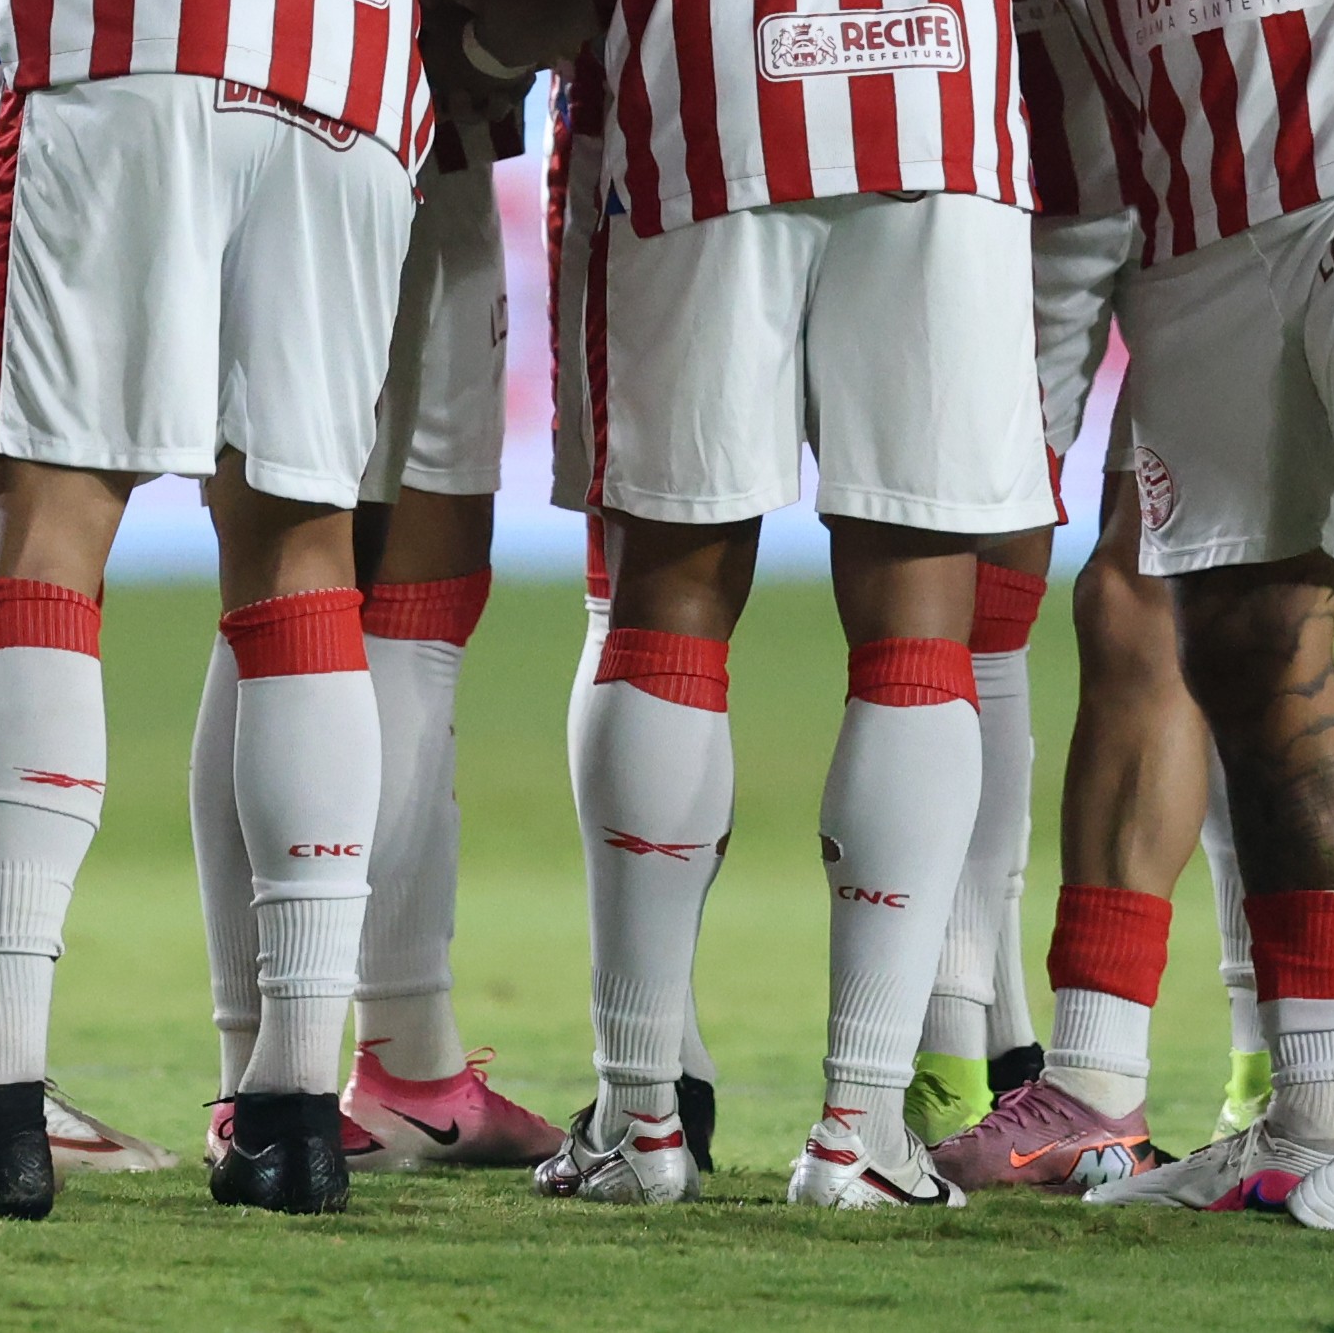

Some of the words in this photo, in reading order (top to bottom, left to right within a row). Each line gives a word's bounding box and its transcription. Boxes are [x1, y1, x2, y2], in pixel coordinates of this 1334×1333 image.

[840, 15, 952, 53] RECIFE
[843, 49, 954, 64] PREFEITURA
[288, 843, 364, 858] CNC
[837, 885, 911, 909] CNC
